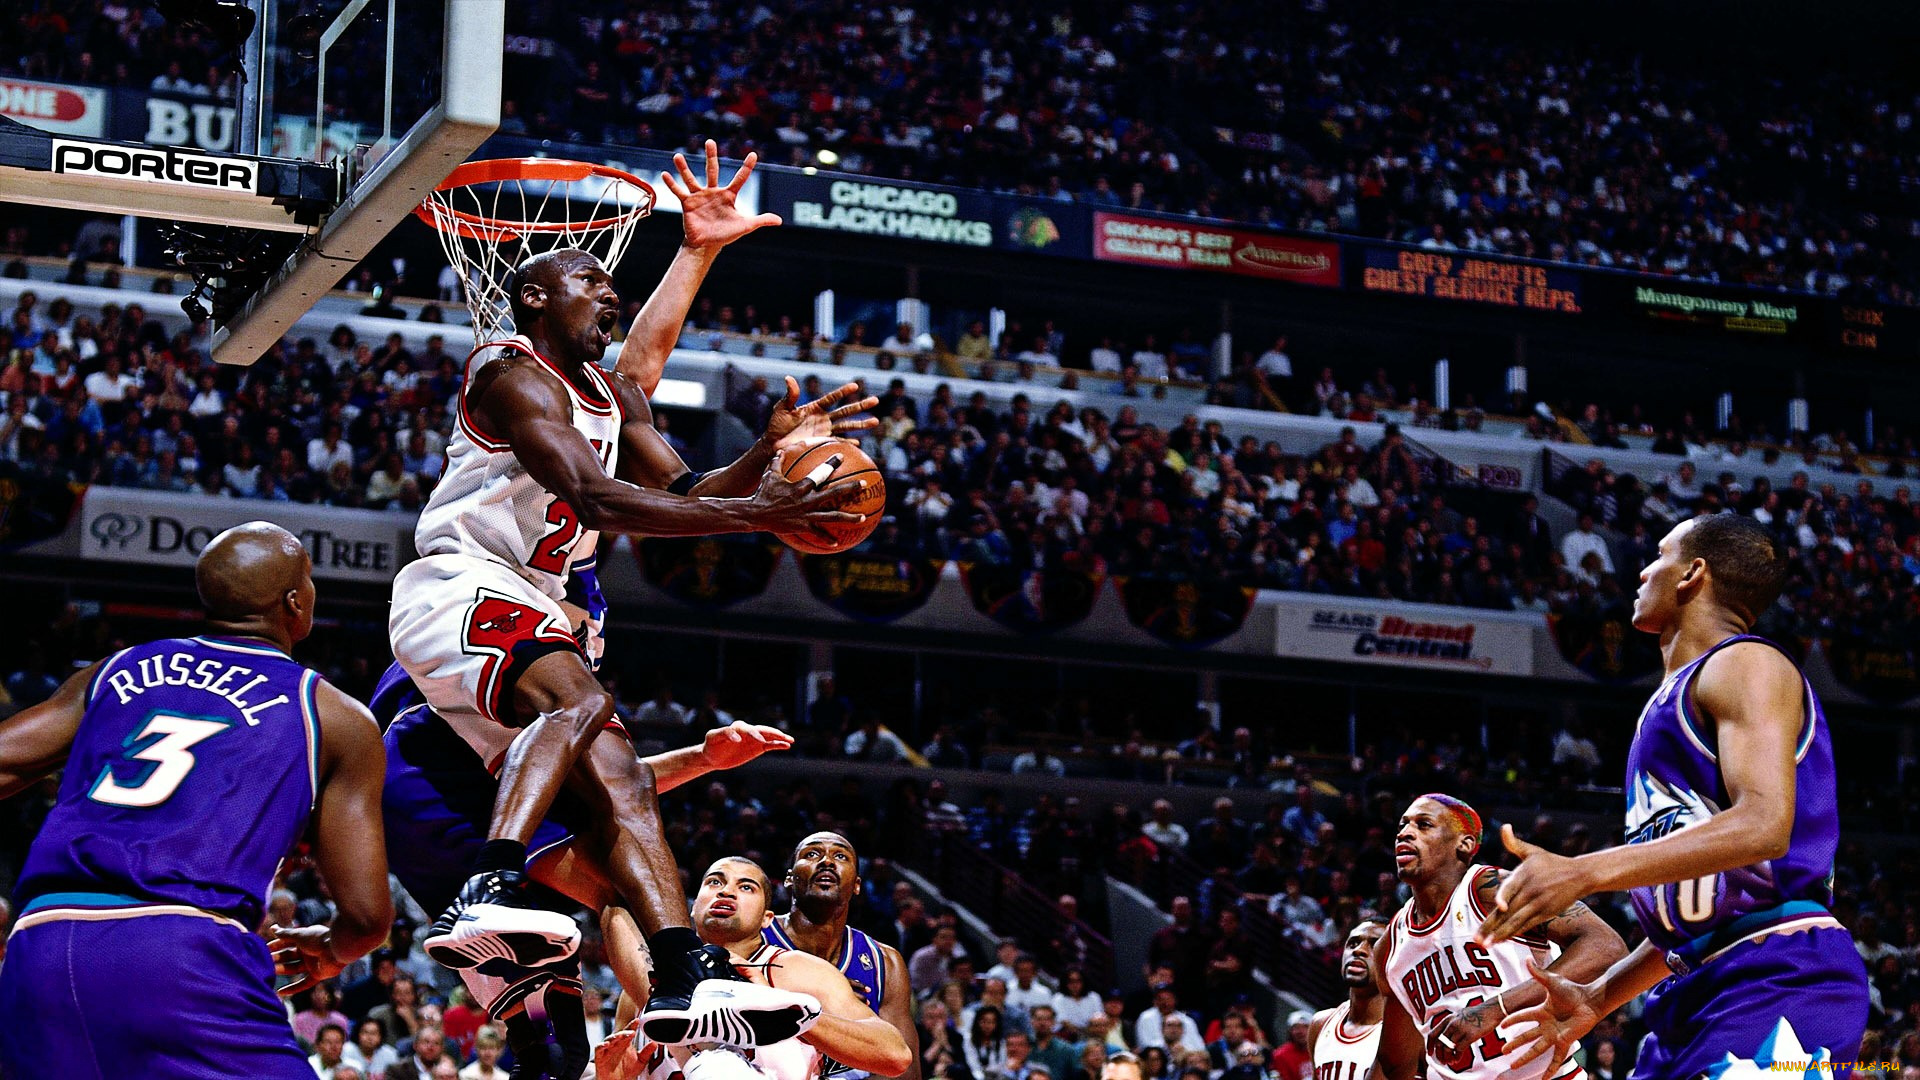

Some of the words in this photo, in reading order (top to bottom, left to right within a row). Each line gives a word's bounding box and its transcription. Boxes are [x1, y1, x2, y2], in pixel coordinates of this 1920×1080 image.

[830, 181, 957, 217] CHICAGO
[793, 201, 992, 246] BLACKHAWKS
[1187, 247, 1232, 266] TEAM
[1397, 251, 1453, 275] GREY
[1459, 259, 1547, 287] JACKETS
[1363, 267, 1426, 294] GUEST
[1434, 275, 1518, 306] SERVICE
[1635, 286, 1748, 317] Montgomery
[1751, 300, 1797, 323] Ward
[1312, 608, 1377, 628] SEARS
[1378, 615, 1475, 642] Brand
[1354, 632, 1474, 659] Central
[107, 653, 290, 727] RUSSELL
[87, 708, 237, 807] 3
[1402, 941, 1503, 1026] BULLS
